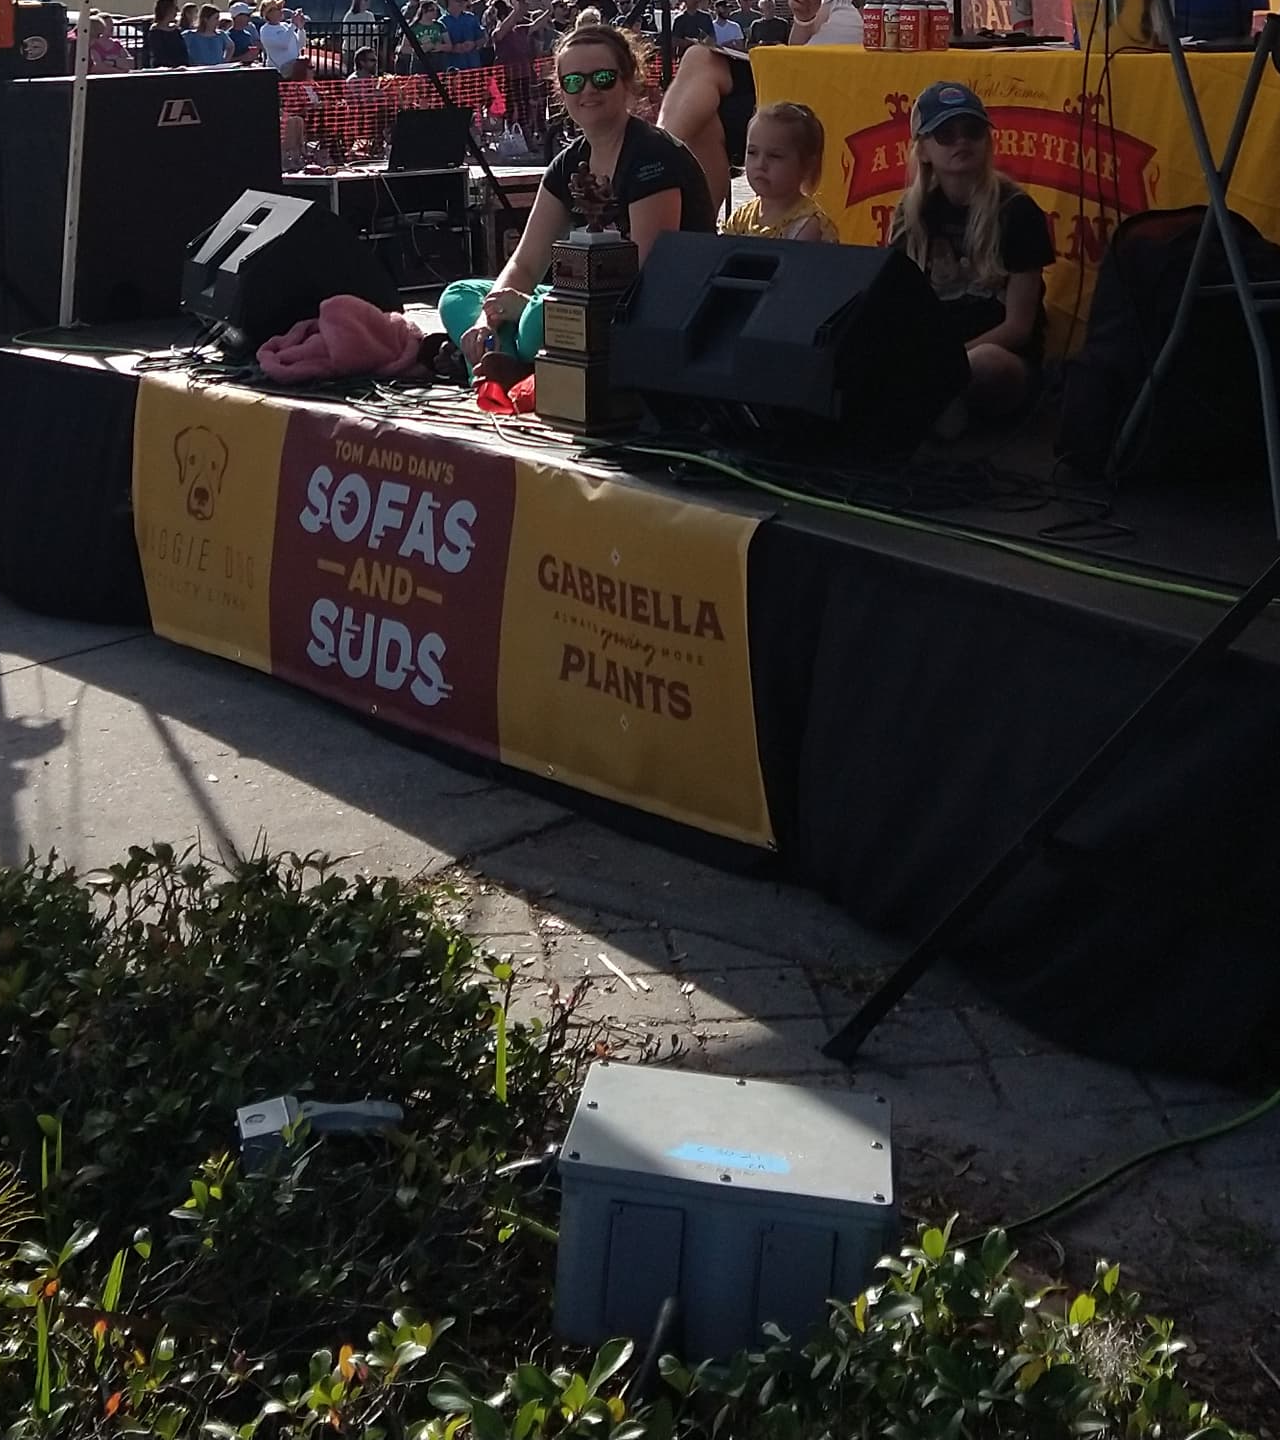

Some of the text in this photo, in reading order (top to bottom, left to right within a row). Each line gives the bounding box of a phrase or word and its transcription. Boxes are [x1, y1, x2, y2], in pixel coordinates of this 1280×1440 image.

[871, 144, 889, 173] A
[335, 440, 456, 485] TOM AND DAN'S
[299, 465, 477, 574] SOFAS
[348, 558, 414, 605] AND
[538, 553, 725, 641] GABRIELLA
[306, 598, 454, 706] SUDS
[559, 643, 693, 721] PLANTS
